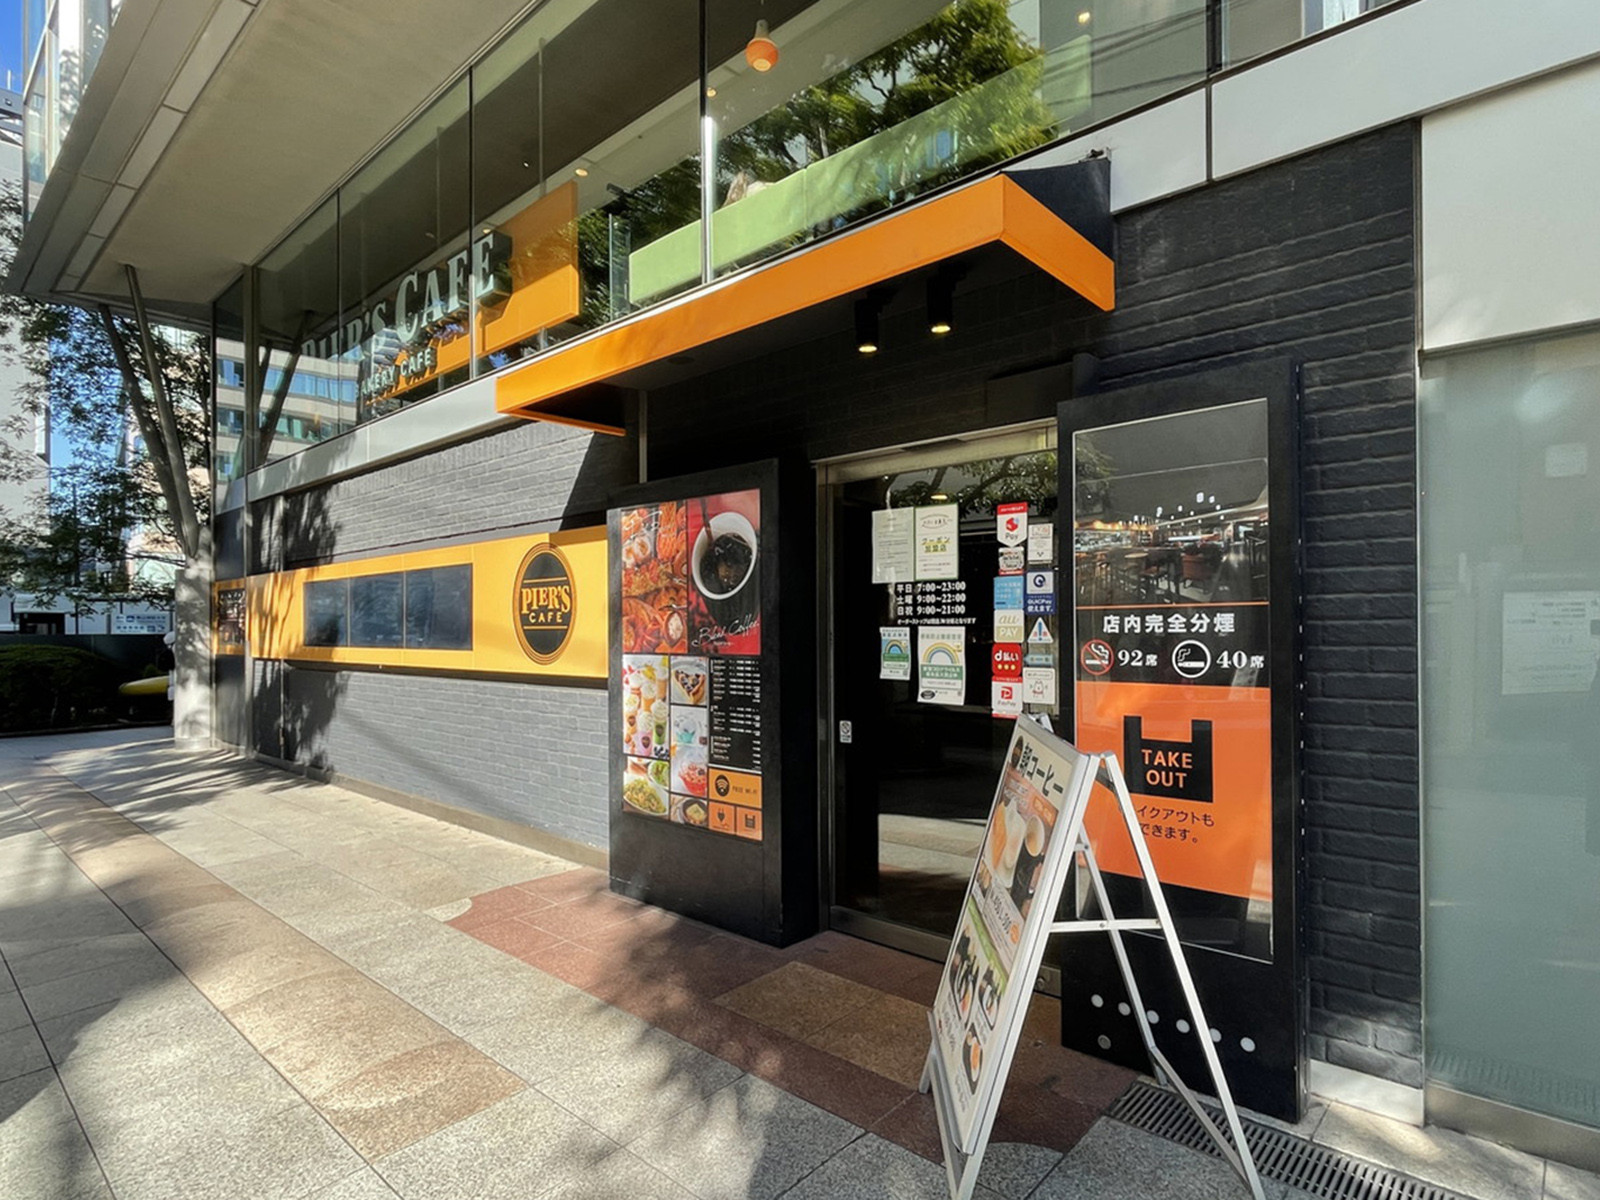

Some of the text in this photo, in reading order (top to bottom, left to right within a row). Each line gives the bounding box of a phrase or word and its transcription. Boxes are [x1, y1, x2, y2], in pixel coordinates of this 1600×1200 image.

[396, 233, 494, 344] CAFE
[401, 348, 431, 376] CAFE
[897, 583, 912, 593] 平日
[521, 585, 571, 614] PIER'S
[897, 595, 913, 605] 土曜
[529, 612, 563, 623] CAFE
[897, 606, 913, 616] 日祝
[1000, 627, 1019, 637] PAY
[1103, 613, 1235, 635] 店内完全分煙
[1141, 749, 1193, 769] TAKE
[1146, 769, 1187, 789] OUT
[1136, 805, 1215, 827] イクアウトも
